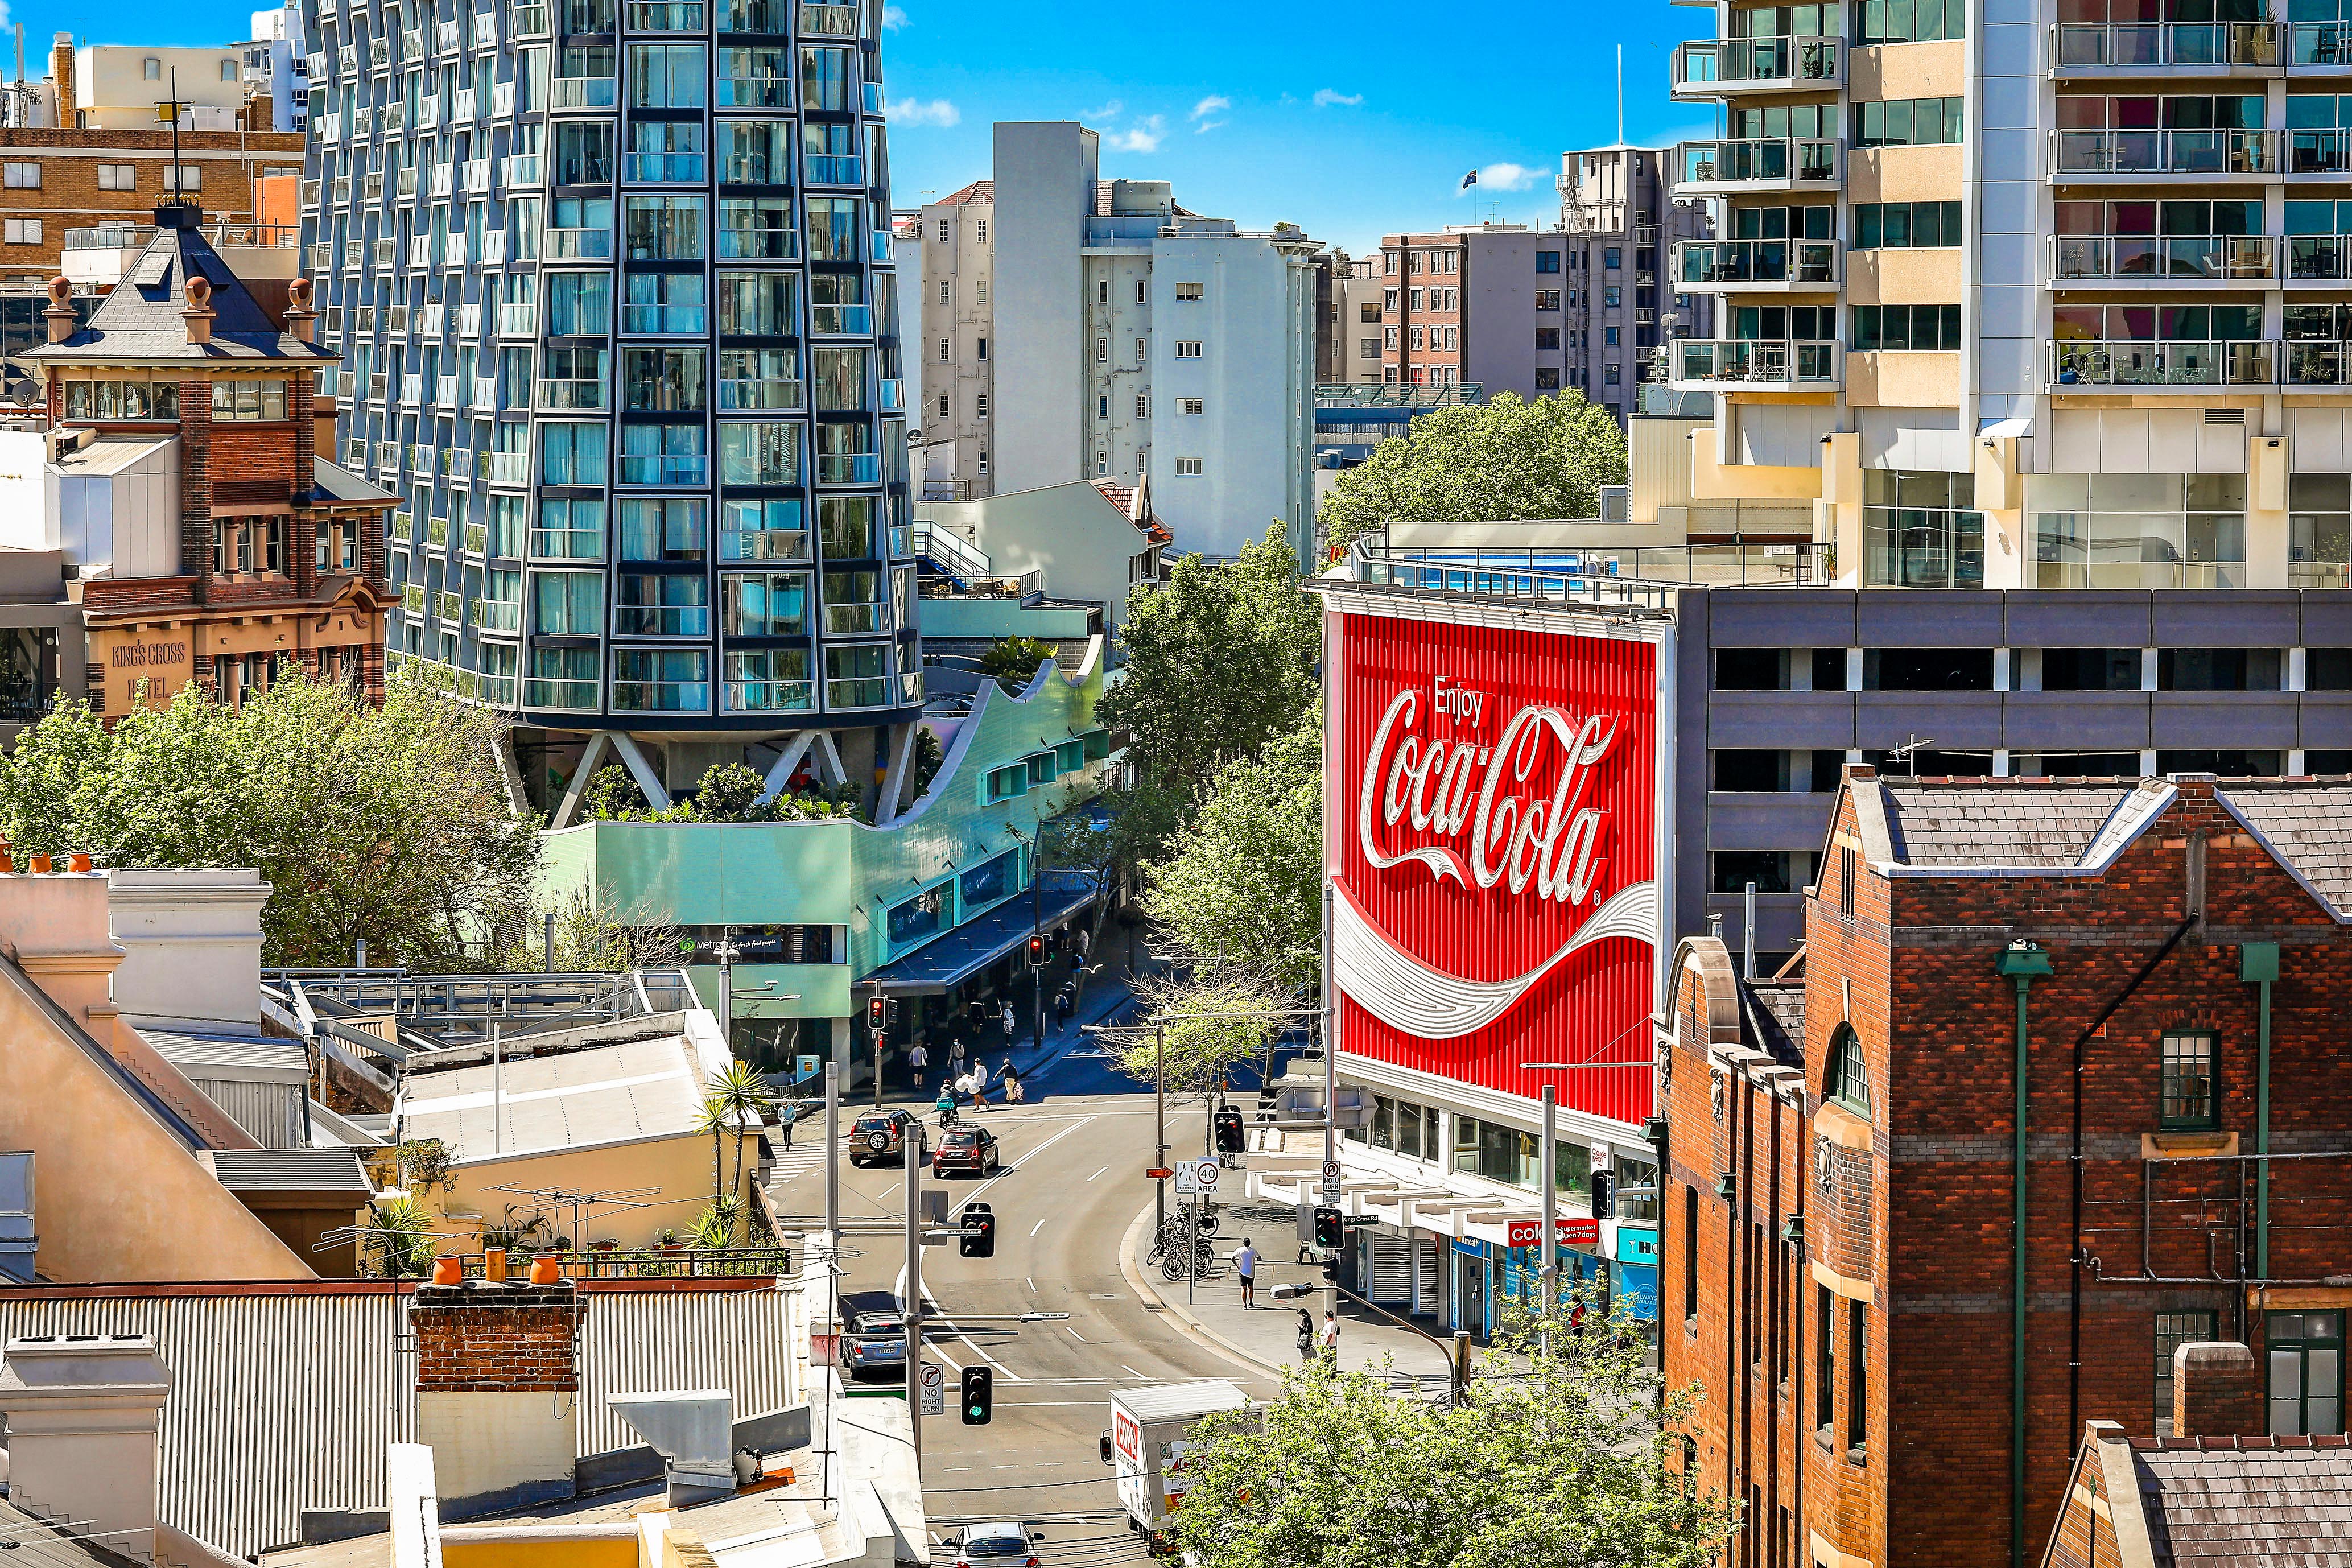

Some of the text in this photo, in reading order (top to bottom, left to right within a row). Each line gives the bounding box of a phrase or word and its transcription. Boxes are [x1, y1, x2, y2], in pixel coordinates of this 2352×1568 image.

[112, 639, 185, 667] KING'S CROSS
[1435, 675, 1483, 728] Enjoy
[751, 940, 762, 948] food
[1200, 1169, 1215, 1179] 40
[924, 1389, 938, 1397] NO
